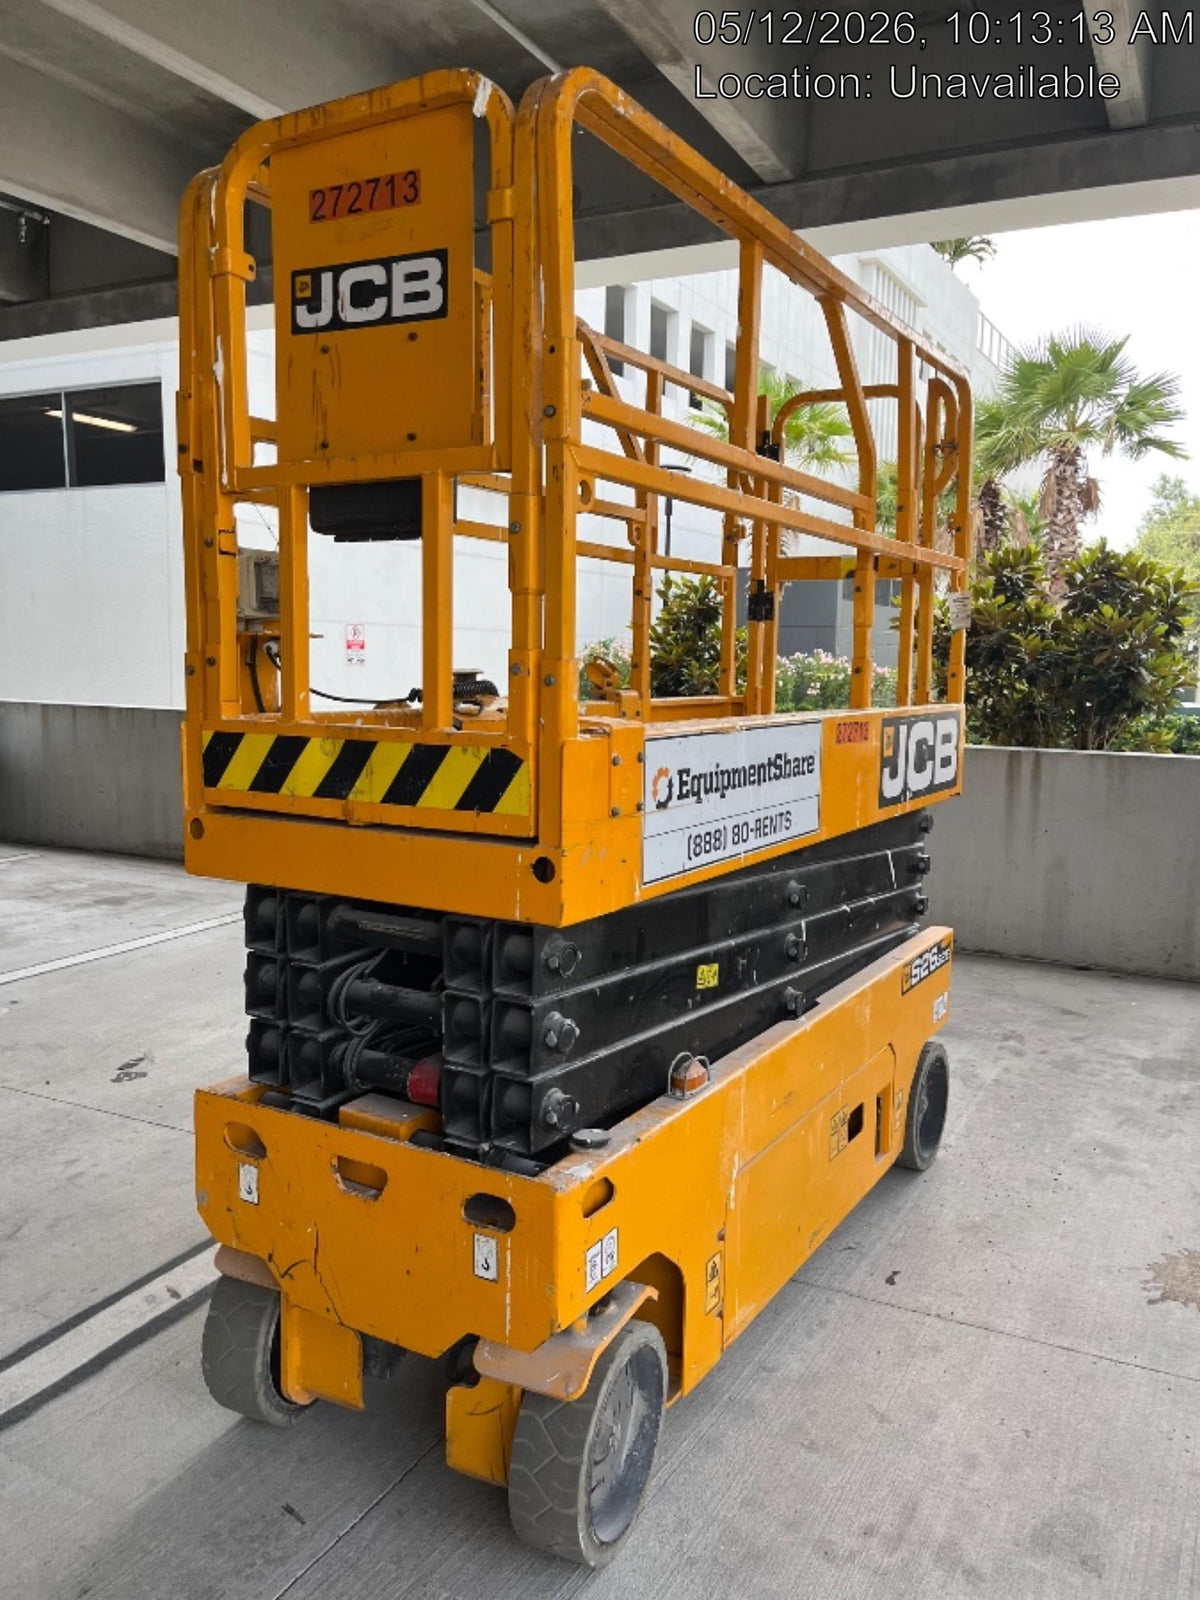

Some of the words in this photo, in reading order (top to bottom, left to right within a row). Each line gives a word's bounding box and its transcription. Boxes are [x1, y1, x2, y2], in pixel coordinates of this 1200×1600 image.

[311, 170, 419, 222] 272713
[295, 256, 444, 328] JCB
[676, 752, 816, 804] EquipmentShare
[881, 718, 958, 799] JCB
[687, 824, 728, 861] (888)
[731, 810, 793, 845] 80-RENTS
